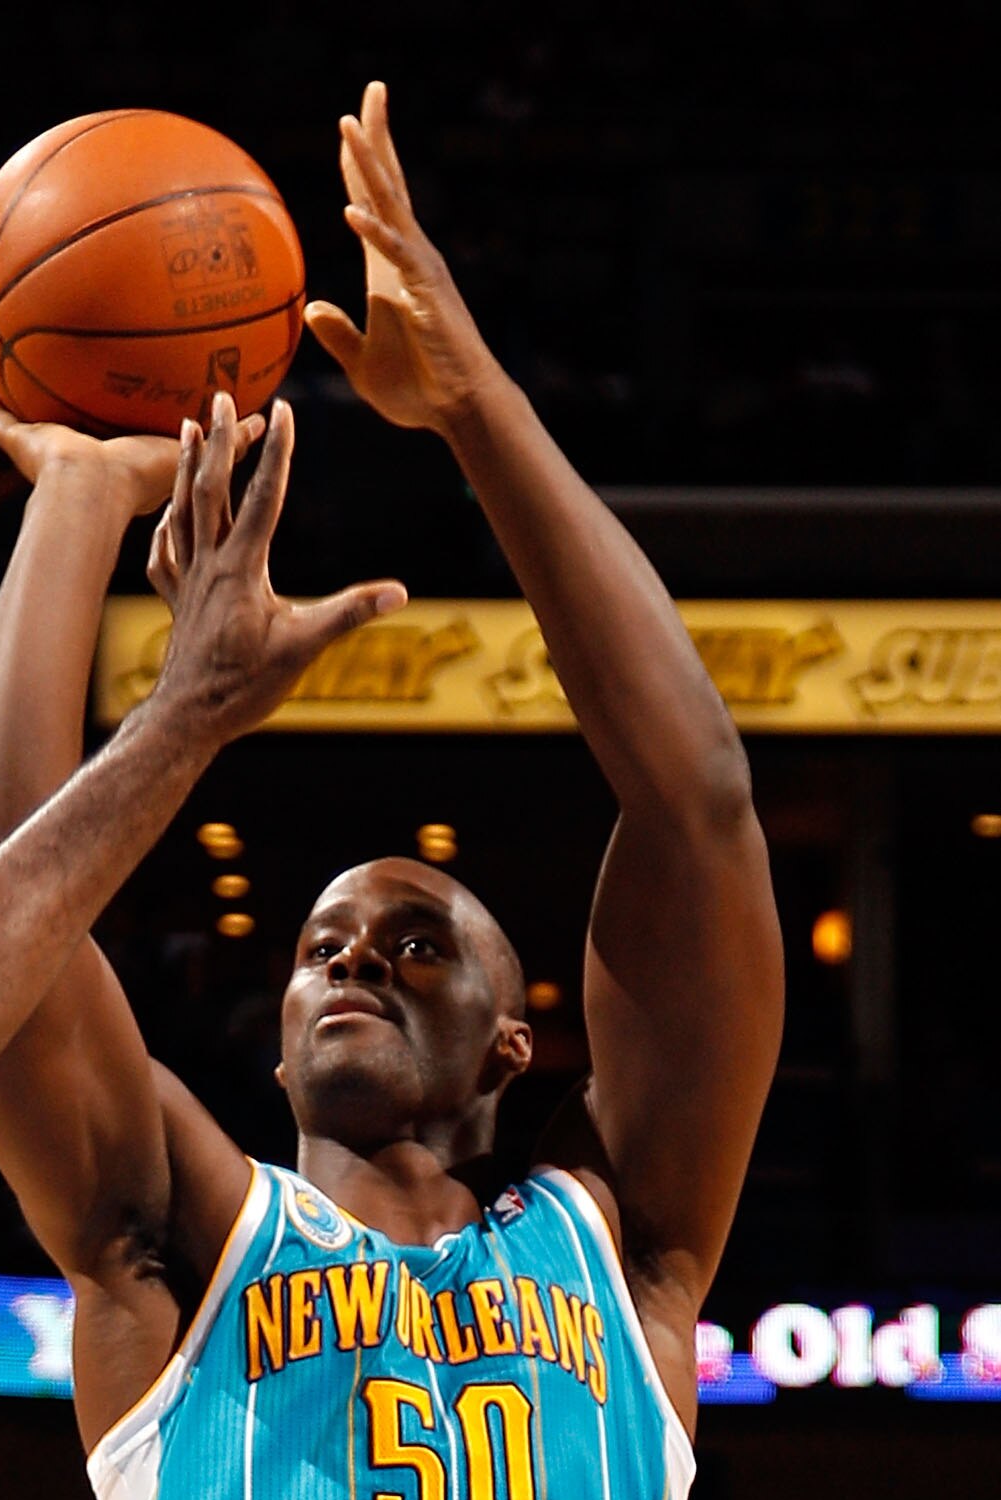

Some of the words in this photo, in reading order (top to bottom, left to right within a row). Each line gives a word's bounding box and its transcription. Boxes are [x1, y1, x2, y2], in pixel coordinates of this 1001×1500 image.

[244, 1261, 389, 1383] NEW
[394, 1261, 608, 1406] ORLEANS
[750, 1303, 940, 1388] Old
